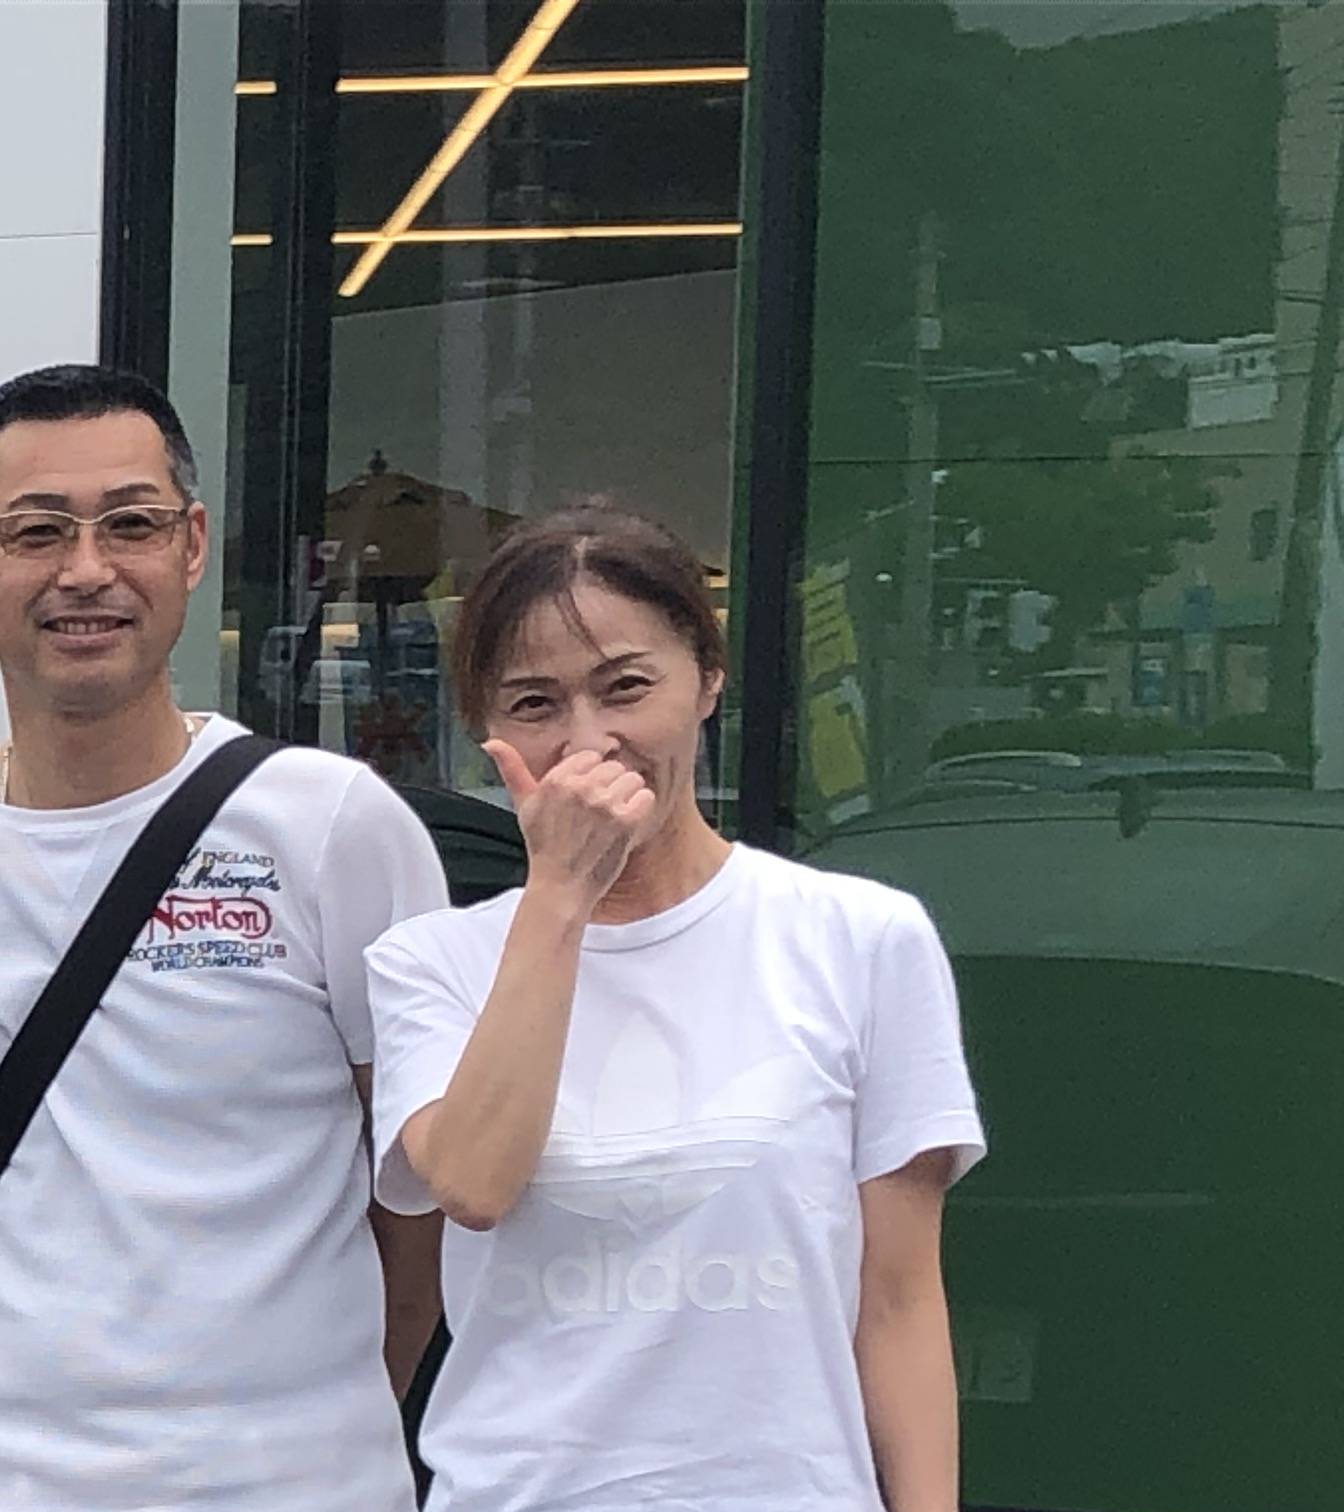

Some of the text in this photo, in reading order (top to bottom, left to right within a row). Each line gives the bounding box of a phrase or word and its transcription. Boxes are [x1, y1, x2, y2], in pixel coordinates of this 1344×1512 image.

[203, 851, 275, 868] ENGLAND
[146, 895, 272, 944] Norton
[197, 941, 245, 956] SPEED
[248, 943, 288, 959] CLUB
[480, 1232, 800, 1316] adidas
